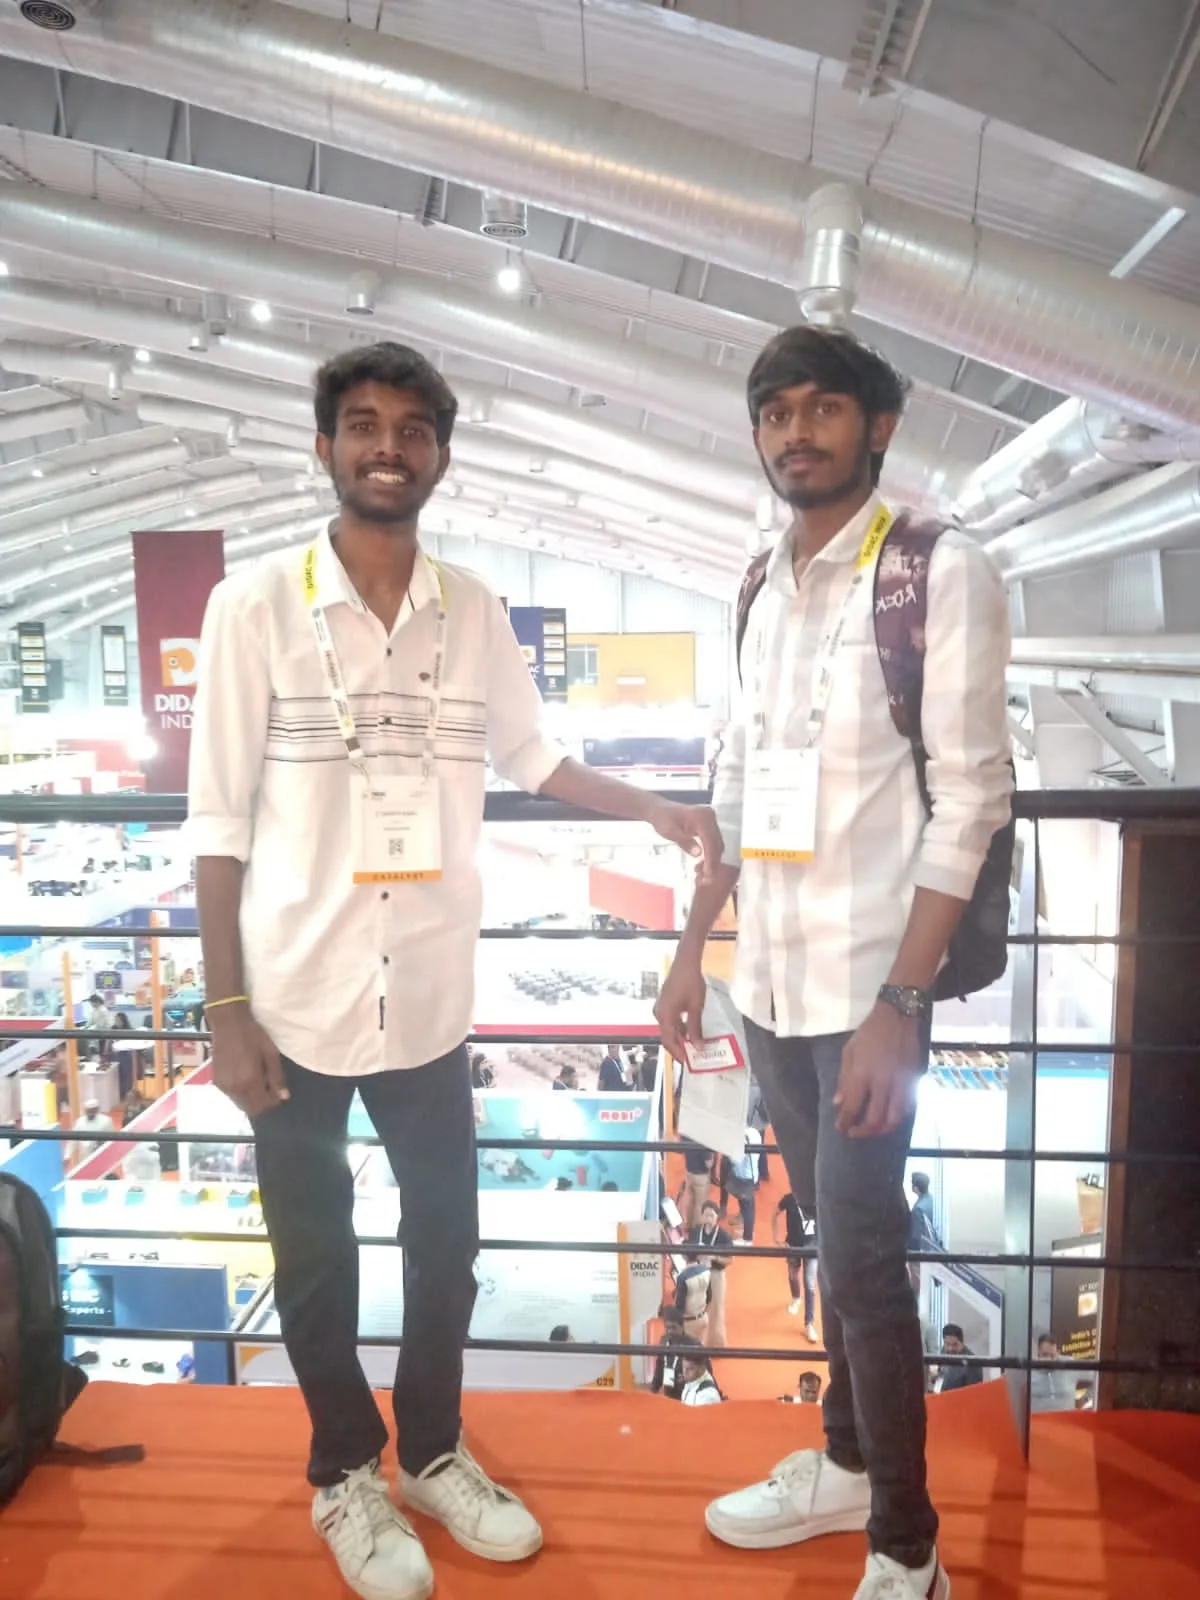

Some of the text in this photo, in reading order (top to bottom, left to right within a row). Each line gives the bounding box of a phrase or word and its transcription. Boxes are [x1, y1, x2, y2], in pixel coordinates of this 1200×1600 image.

[154, 693, 195, 712] DID
[161, 714, 193, 729] IND
[630, 1261, 660, 1271] DIDAC
